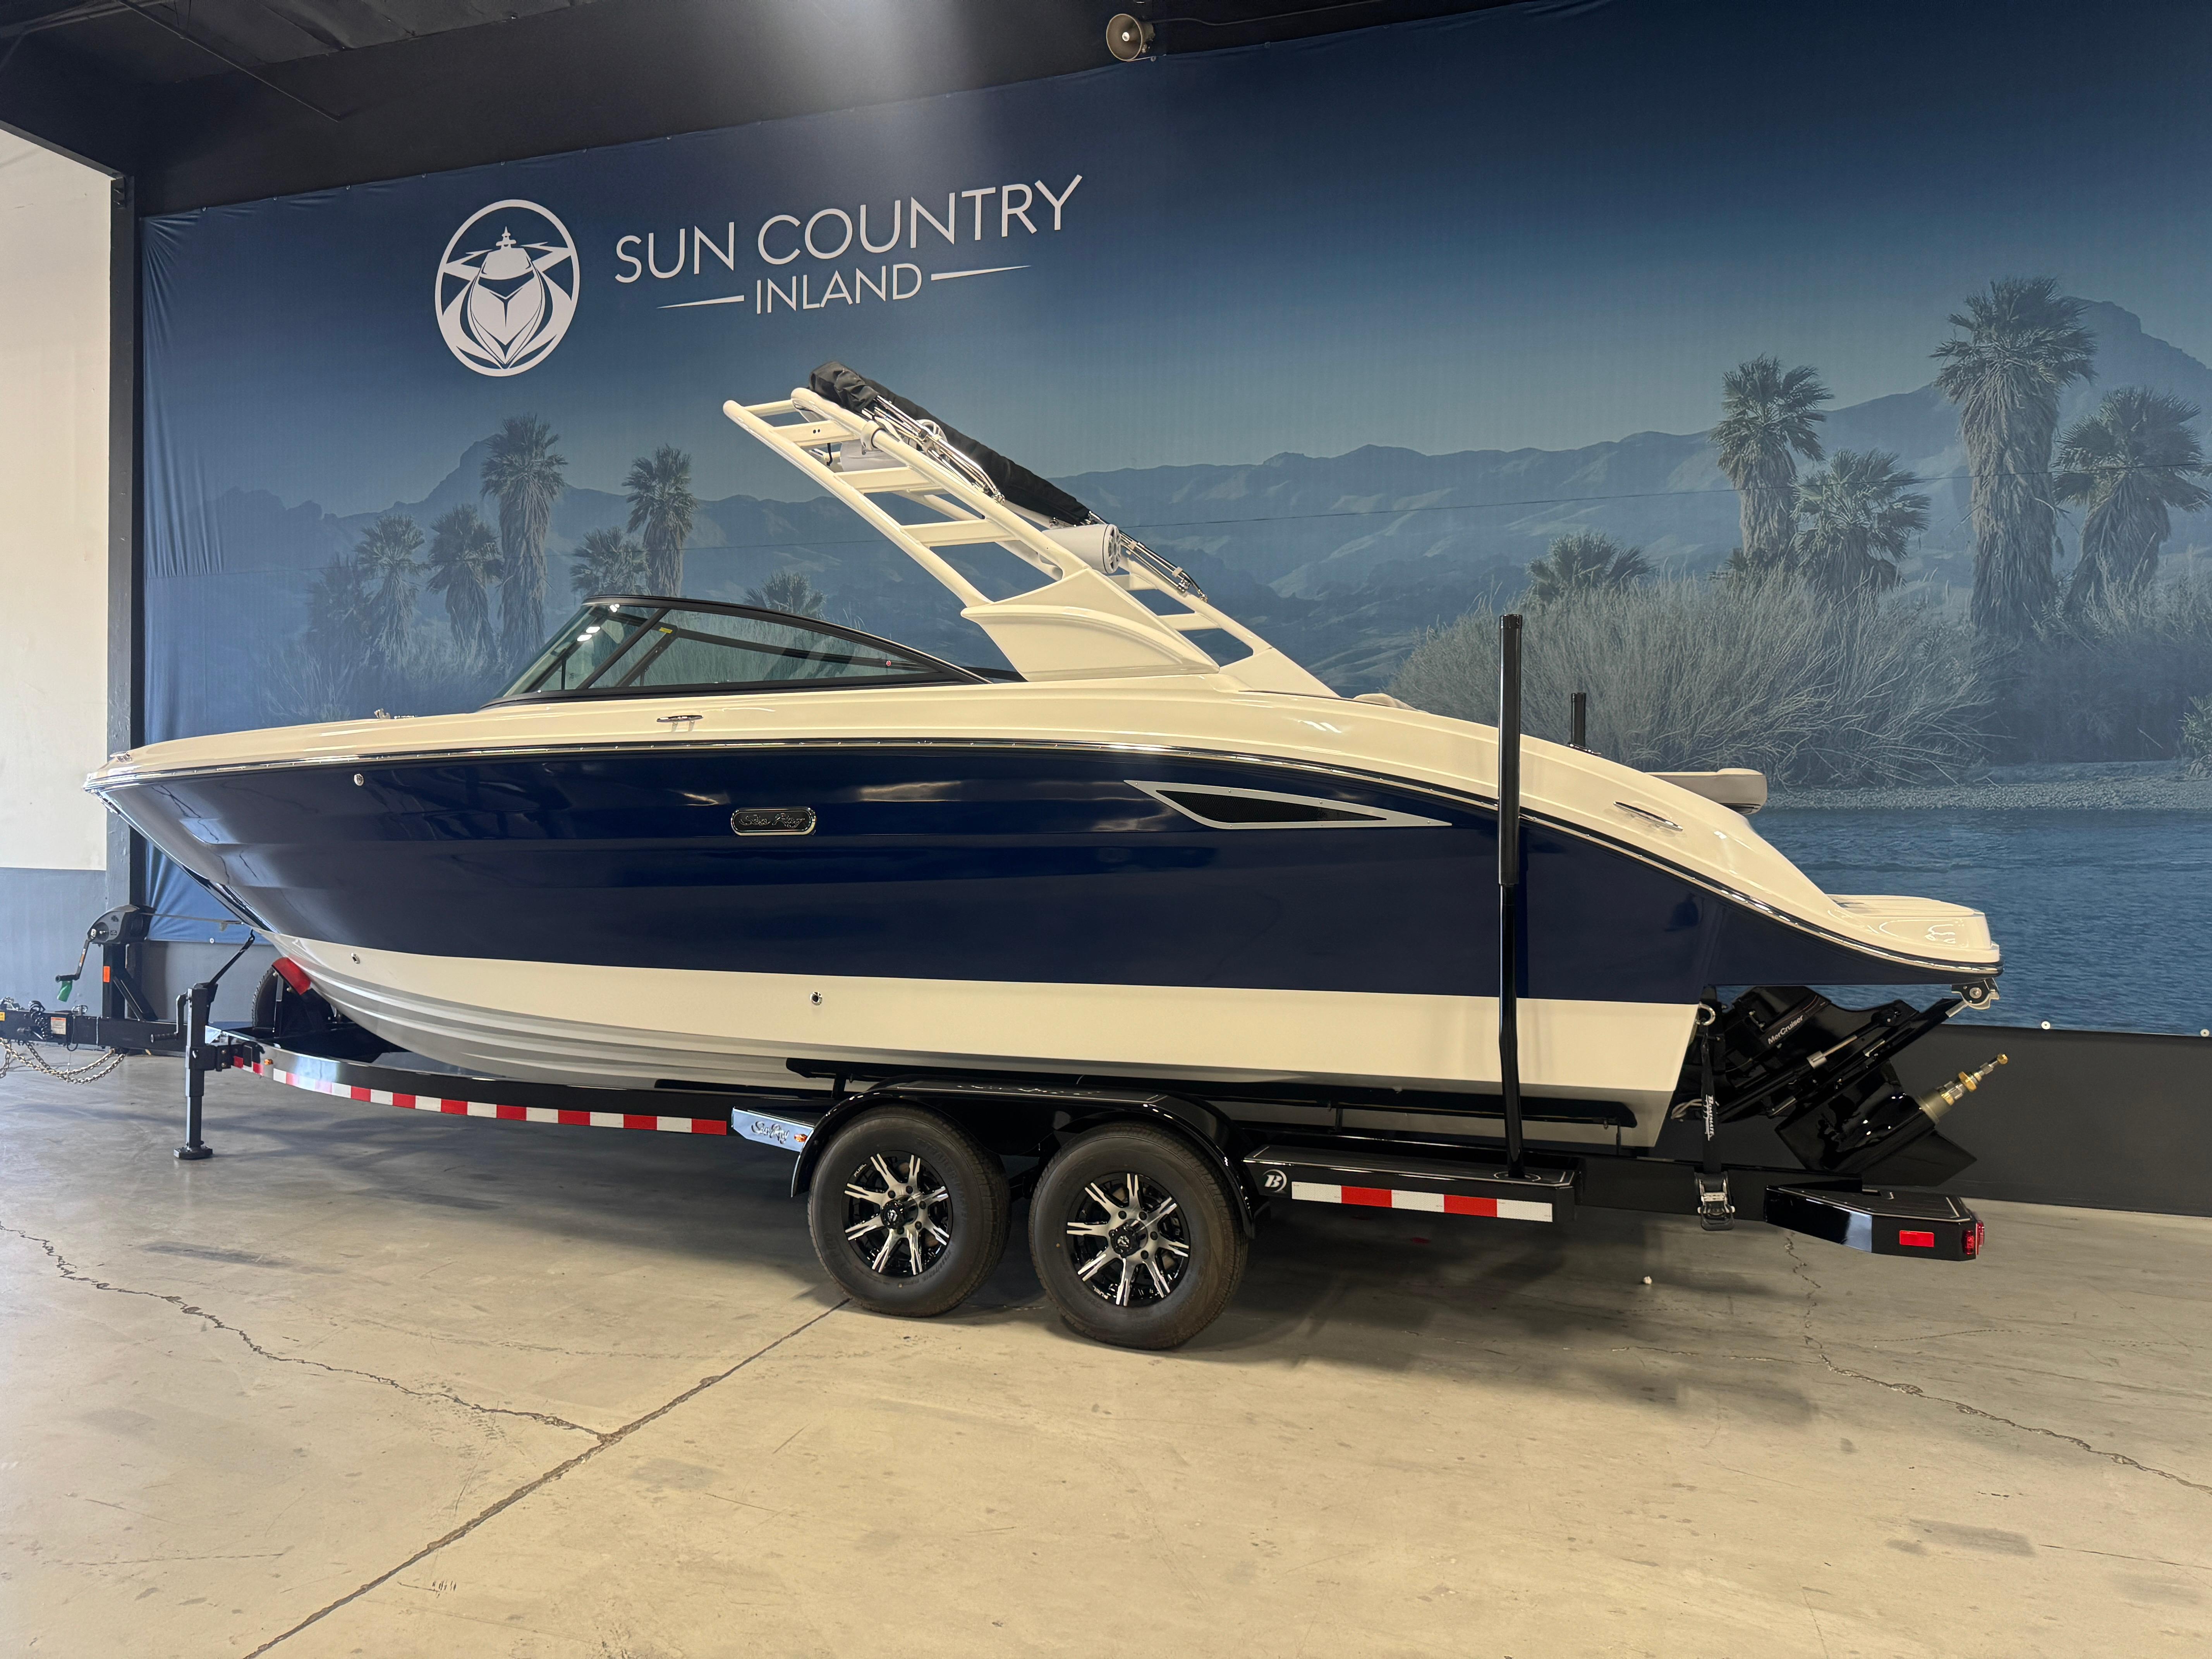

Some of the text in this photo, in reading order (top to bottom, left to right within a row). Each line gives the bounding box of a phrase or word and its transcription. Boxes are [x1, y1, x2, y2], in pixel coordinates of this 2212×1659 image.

[615, 175, 1082, 283] SUN COUNTRY
[757, 263, 922, 314] INLAND
[1767, 1015, 1803, 1044] MerCruiser
[854, 1164, 867, 1177] FUEL
[1093, 1285, 1109, 1299] FUEL
